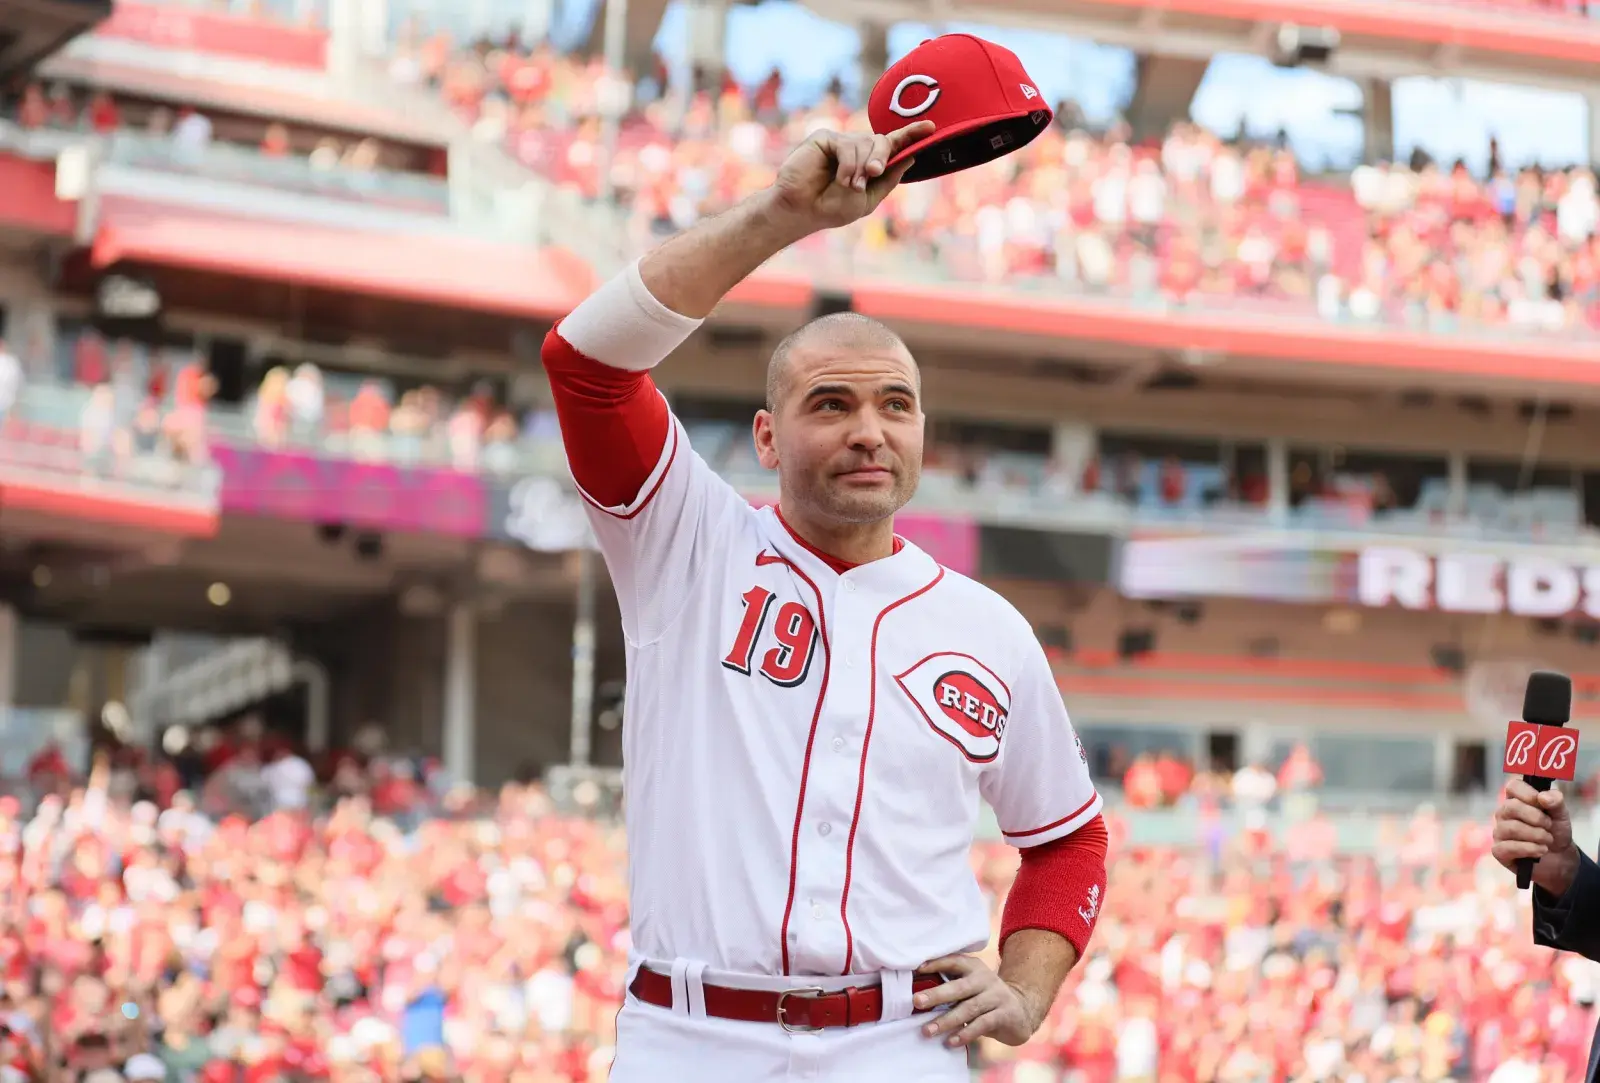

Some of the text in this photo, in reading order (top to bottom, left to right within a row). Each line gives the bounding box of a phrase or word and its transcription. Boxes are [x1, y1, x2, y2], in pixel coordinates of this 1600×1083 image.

[889, 74, 942, 118] C
[1358, 547, 1600, 618] RED
[720, 584, 819, 688] 19
[940, 682, 1008, 740] REDS
[1506, 730, 1537, 766] B
[1538, 735, 1576, 771] B
